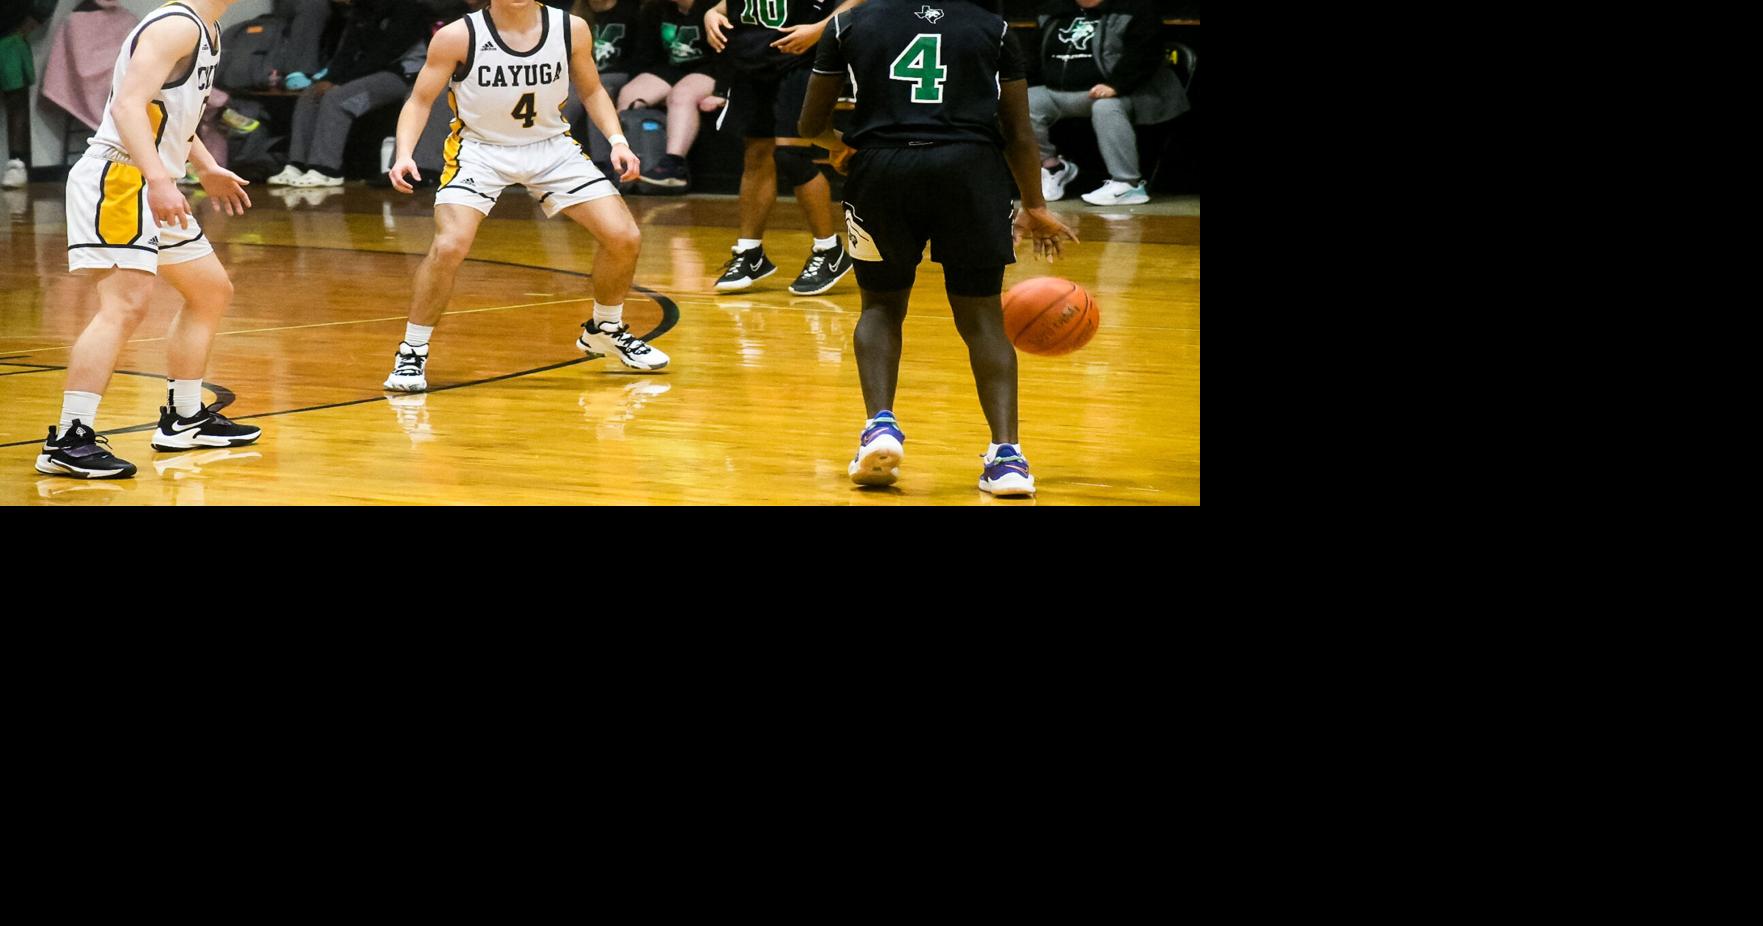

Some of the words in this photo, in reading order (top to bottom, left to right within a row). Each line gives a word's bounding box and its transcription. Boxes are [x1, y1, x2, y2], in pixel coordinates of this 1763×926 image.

[478, 62, 562, 87] CAYUGA
[889, 33, 948, 104] 4
[511, 93, 537, 128] 4
